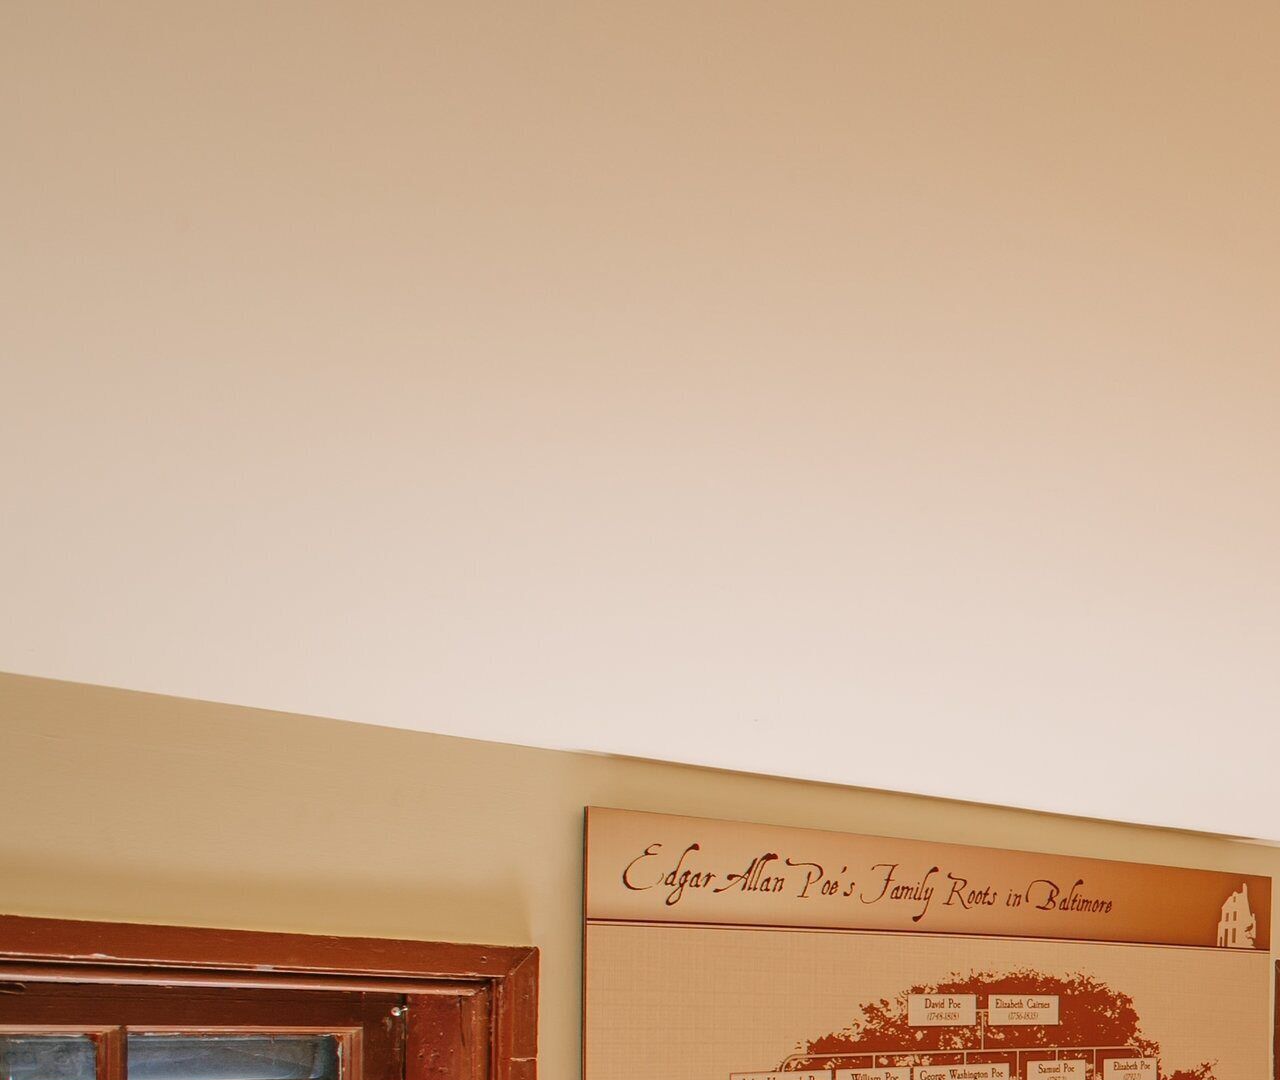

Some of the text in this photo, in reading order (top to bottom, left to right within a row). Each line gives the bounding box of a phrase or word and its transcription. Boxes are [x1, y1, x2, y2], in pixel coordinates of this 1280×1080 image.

[622, 842, 1113, 922] Edgar Allan Poe's Family Roots in Baltimore
[924, 998, 962, 1010] David Poe
[991, 1067, 1005, 1080] Poe
